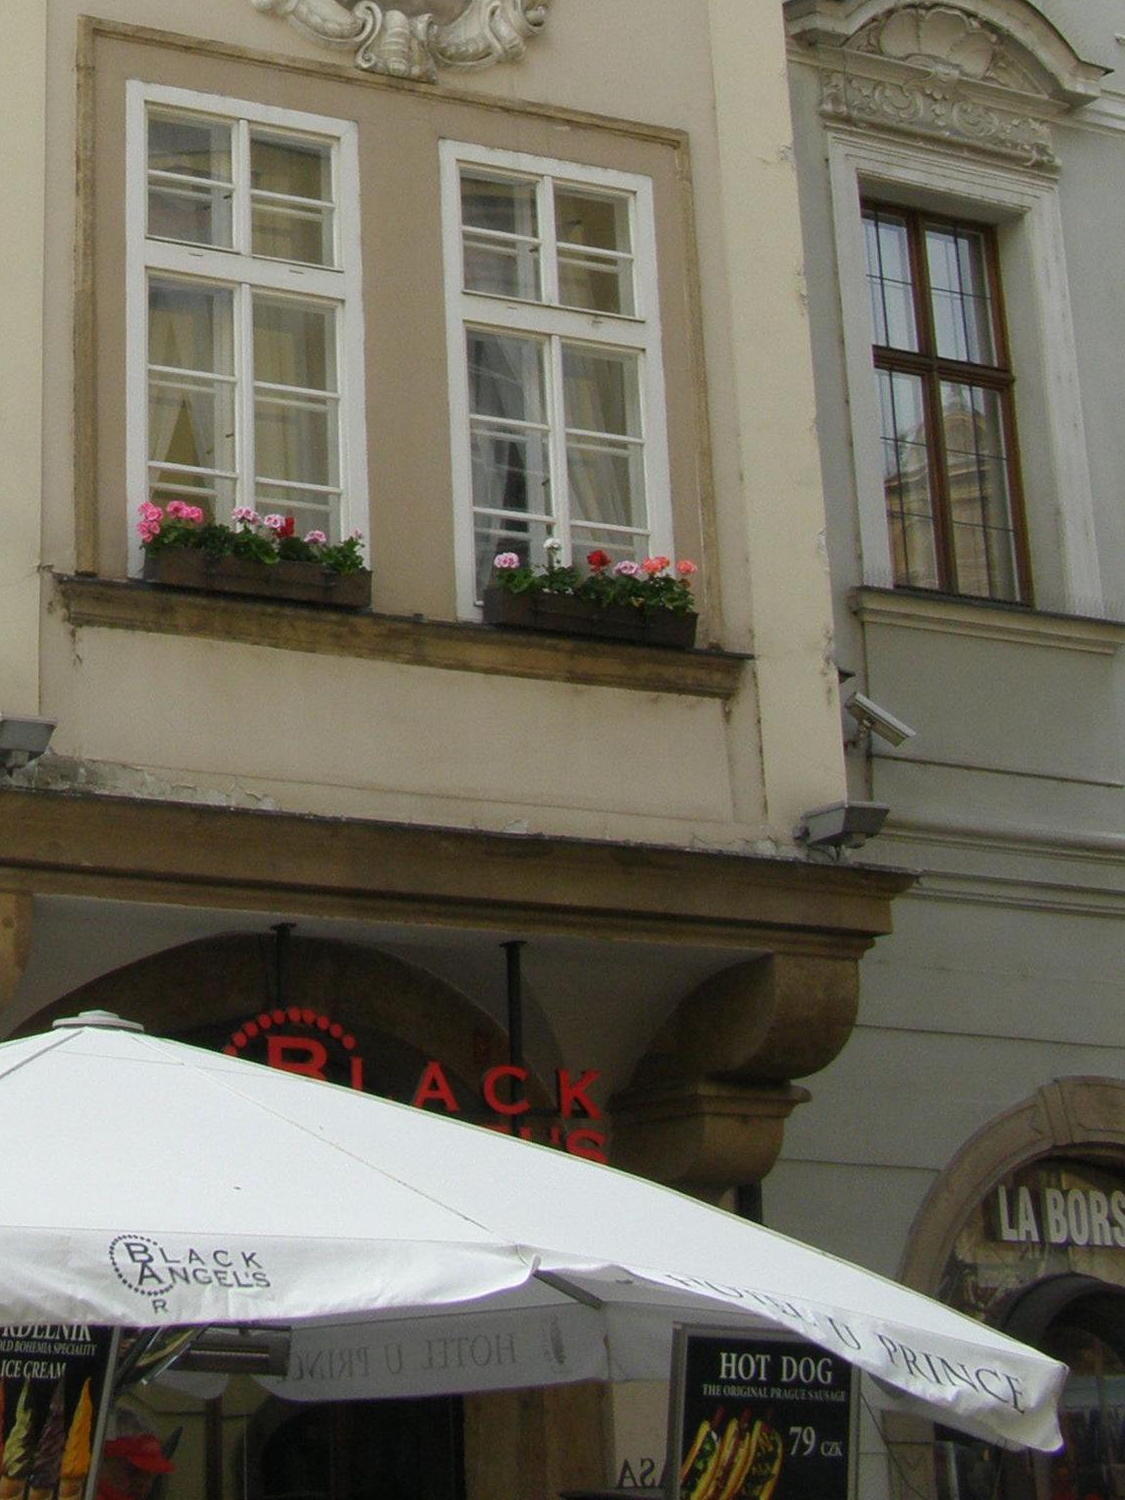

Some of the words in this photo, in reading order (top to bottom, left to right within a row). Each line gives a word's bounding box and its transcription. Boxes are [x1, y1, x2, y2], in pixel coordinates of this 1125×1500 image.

[998, 1184, 1040, 1242] LA
[124, 1242, 264, 1270] BLACK
[138, 1261, 272, 1289] ANGEL'S
[0, 1359, 23, 1379] ICE
[23, 1360, 67, 1380] CREAM
[718, 1351, 771, 1382] HOT
[781, 1355, 833, 1385] DOG
[825, 1316, 862, 1351] U
[876, 1332, 1026, 1414] PRINCE
[702, 1383, 722, 1396] THE
[722, 1385, 768, 1398] ORIGINAL
[789, 1426, 816, 1457] 79
[820, 1440, 843, 1457] CZK
